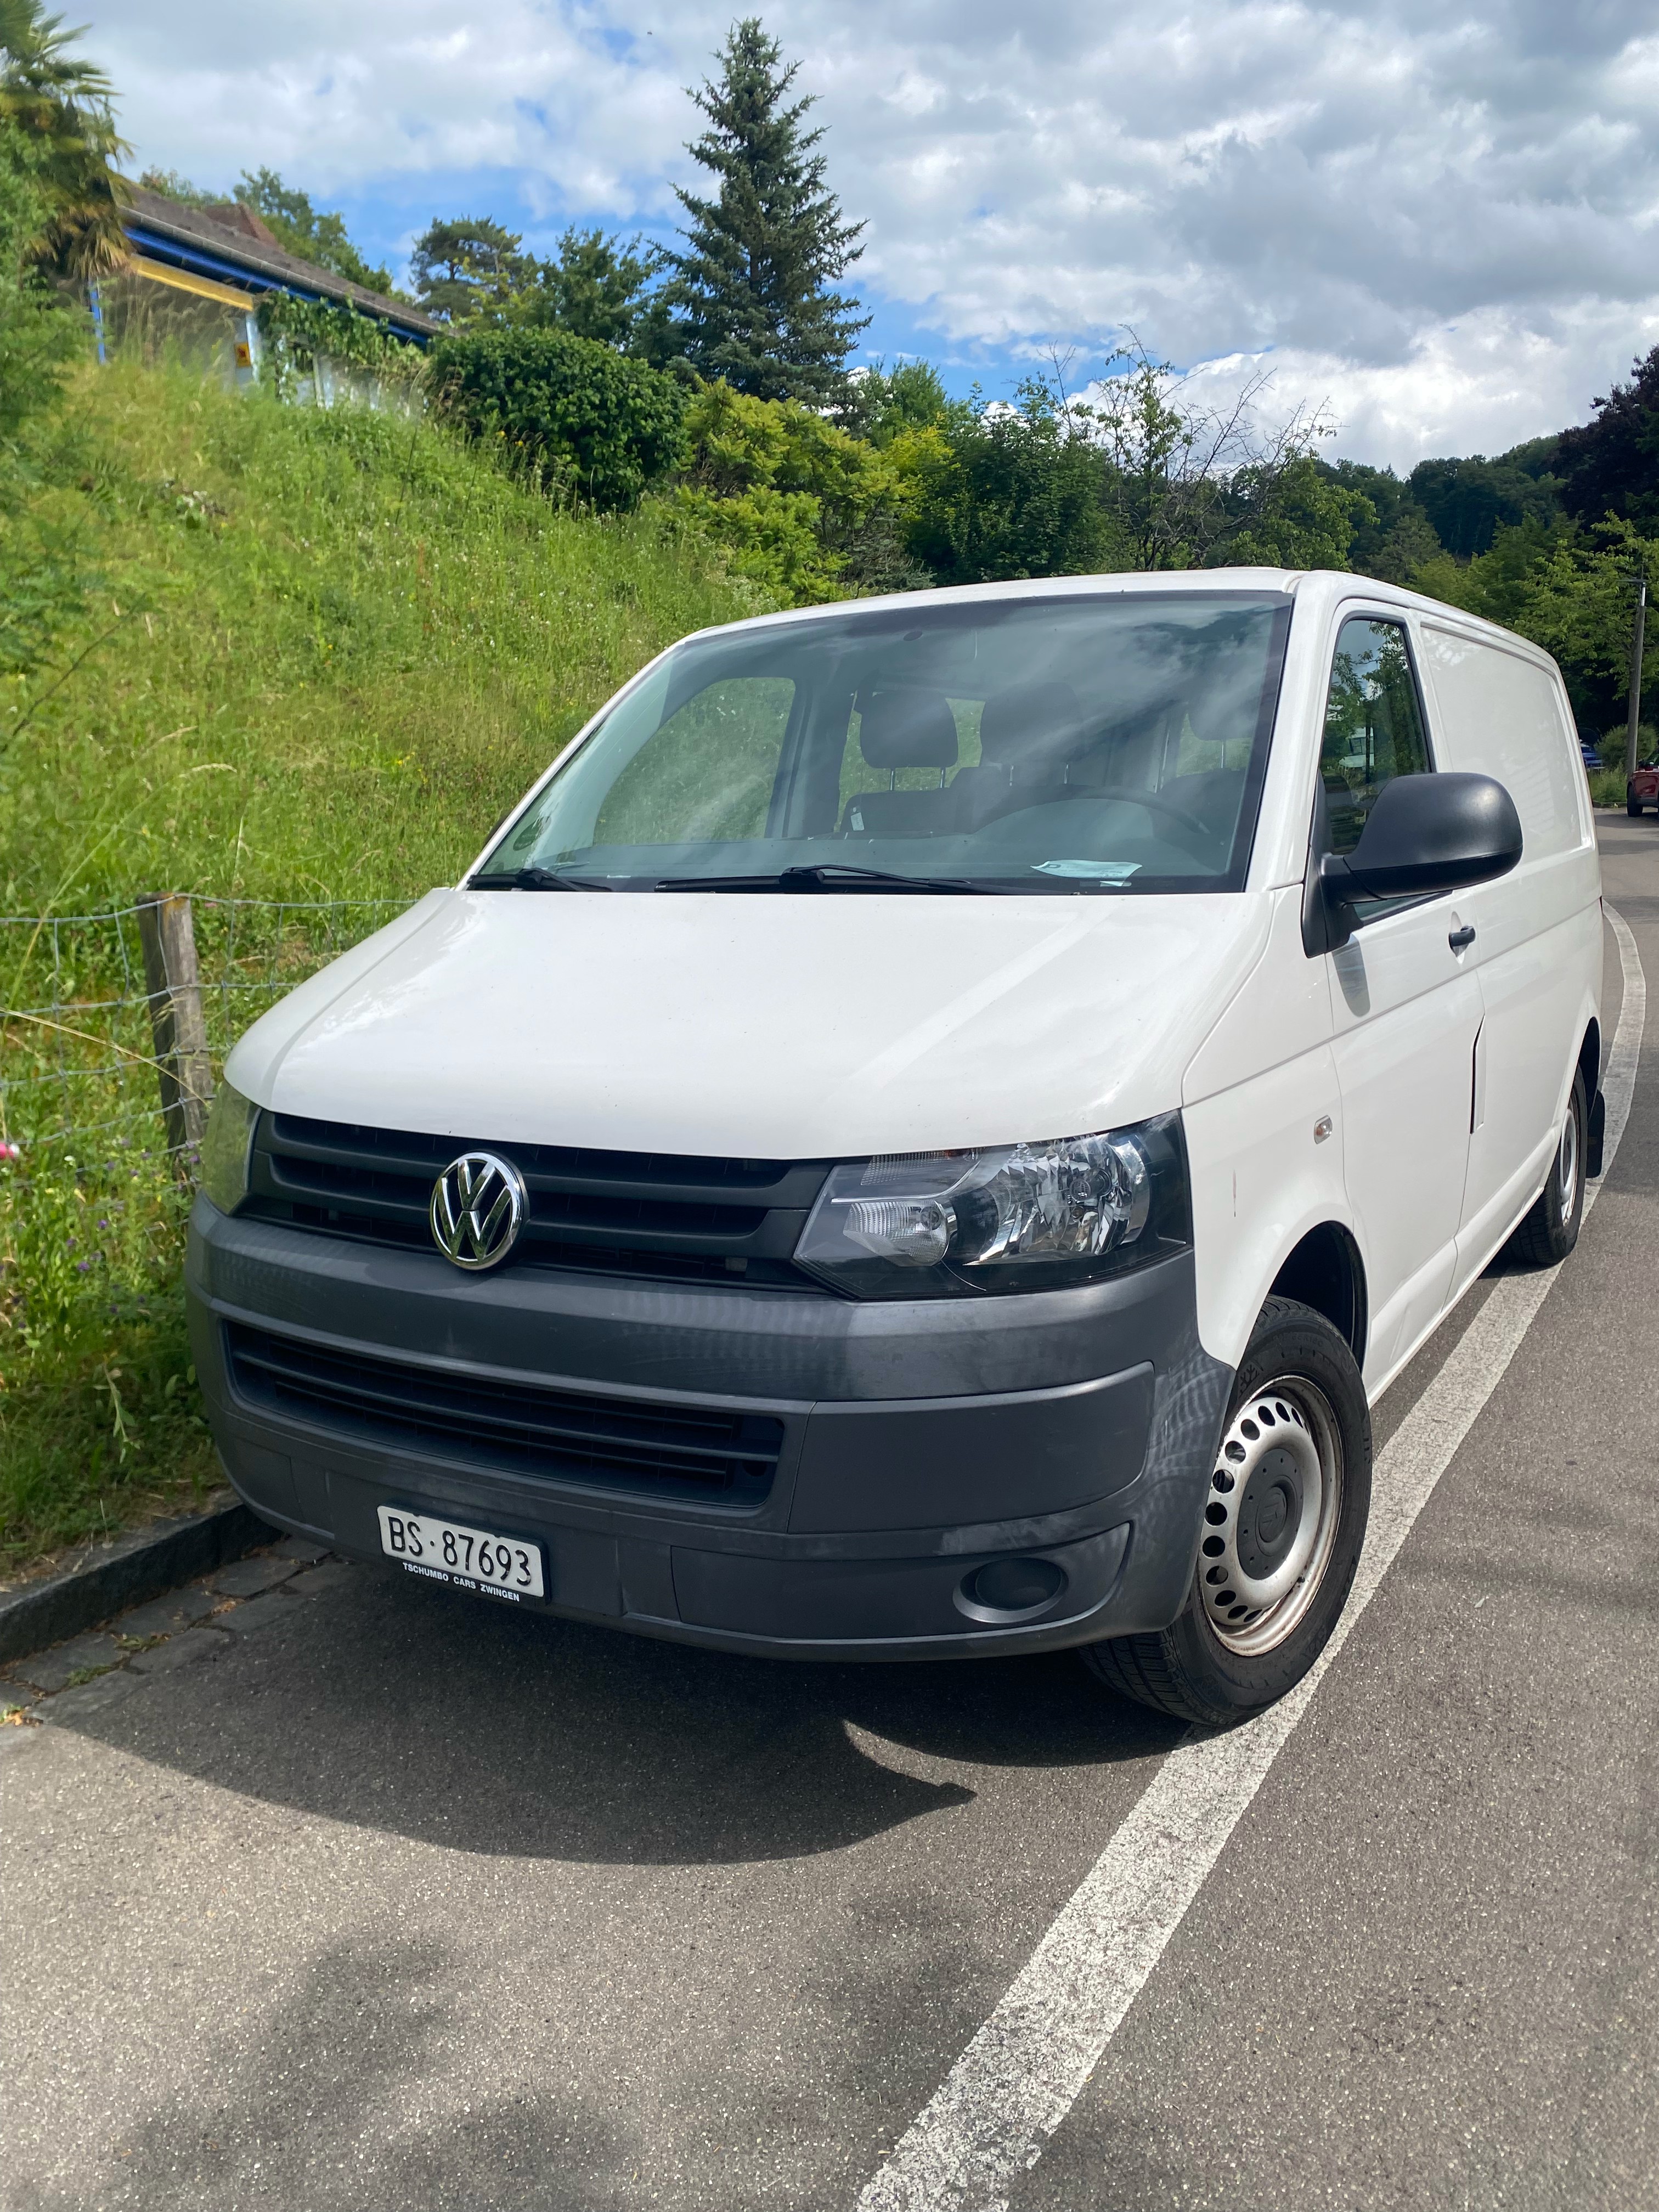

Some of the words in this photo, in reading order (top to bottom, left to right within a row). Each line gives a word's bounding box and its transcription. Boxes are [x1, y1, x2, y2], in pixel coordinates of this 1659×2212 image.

[435, 1156, 515, 1262] VW
[402, 1562, 449, 1582] TSCHUMBO
[453, 1576, 476, 1589] CARS
[480, 1583, 520, 1602] ZWINGEN
